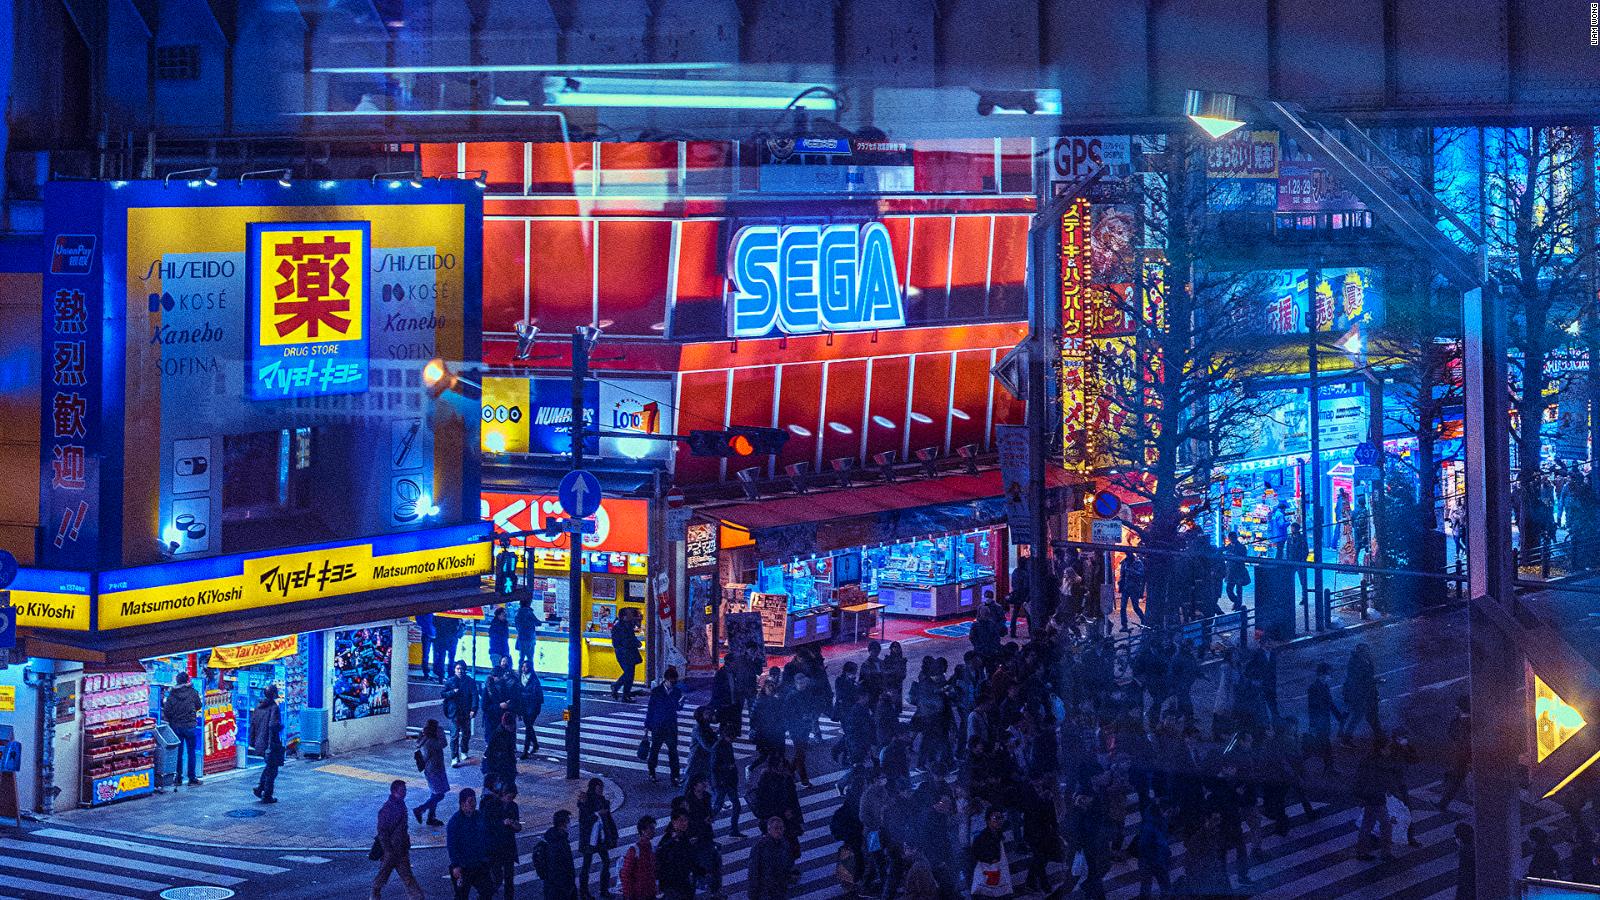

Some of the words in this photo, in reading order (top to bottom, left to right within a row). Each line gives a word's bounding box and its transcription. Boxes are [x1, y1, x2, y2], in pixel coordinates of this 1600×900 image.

[1054, 137, 1103, 176] GPS
[139, 260, 235, 281] SHISEIDO
[374, 254, 456, 272] SHISEIDO
[274, 236, 352, 338] 薬
[732, 222, 906, 337] SEGA
[180, 289, 227, 311] KOSÉ
[383, 311, 446, 332] Kanebo
[150, 321, 224, 345] Kanebo
[1063, 337, 1083, 350] 2F
[283, 346, 309, 357] DRUG
[311, 344, 340, 355] STORE
[388, 343, 434, 360] SOFIN
[155, 356, 219, 377] SOFINA
[259, 358, 363, 395] マツモトキヨシ
[481, 404, 523, 424] oto
[535, 406, 594, 426] NUMBS
[612, 409, 641, 429] LOTO
[643, 401, 658, 434] 7
[481, 498, 567, 543] くじ
[373, 562, 436, 579] Matsumoto
[437, 553, 476, 571] KiYoshi
[260, 560, 357, 597] マツモトキヨシ
[26, 602, 76, 619] KiYoshi
[121, 595, 196, 617] Matsumoto
[197, 585, 243, 605] KiYoshi
[236, 646, 251, 658] Tax
[251, 643, 271, 656] Free
